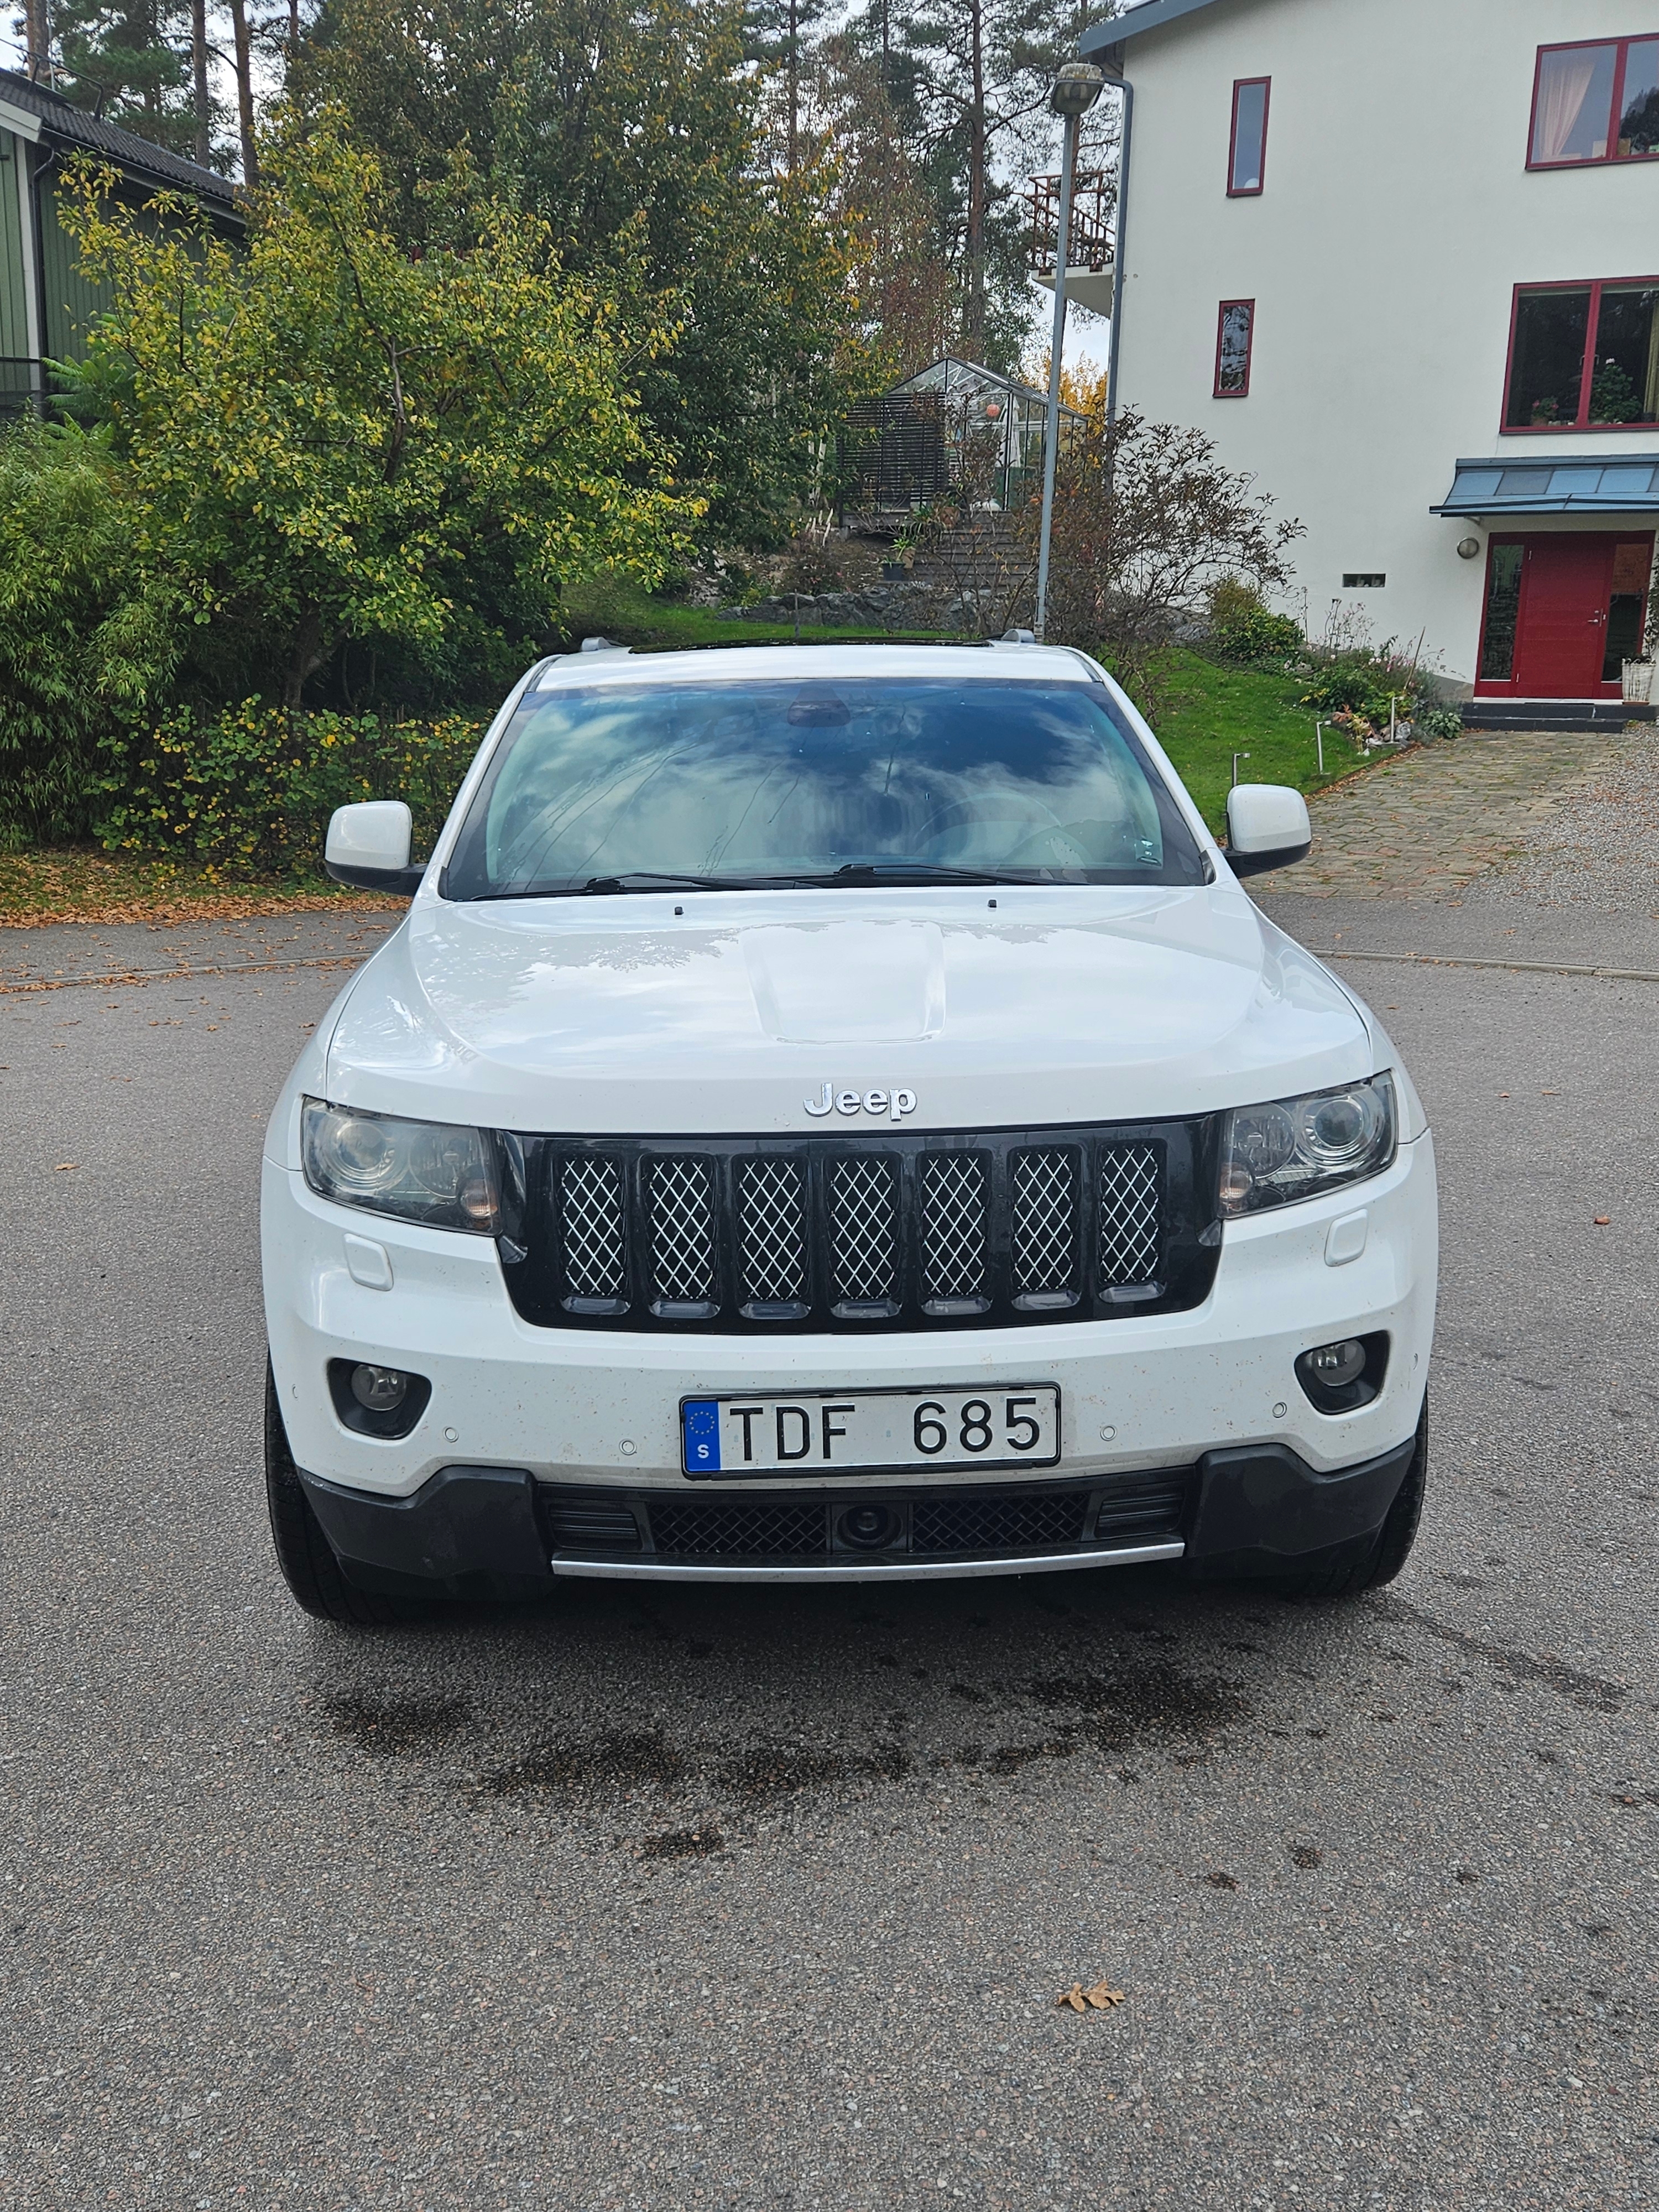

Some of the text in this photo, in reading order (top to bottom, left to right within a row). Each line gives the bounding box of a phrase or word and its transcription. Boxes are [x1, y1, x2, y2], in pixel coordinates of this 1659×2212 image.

[804, 1082, 917, 1121] Jeep
[729, 1396, 1040, 1460] TDF 685
[697, 1444, 709, 1459] S
